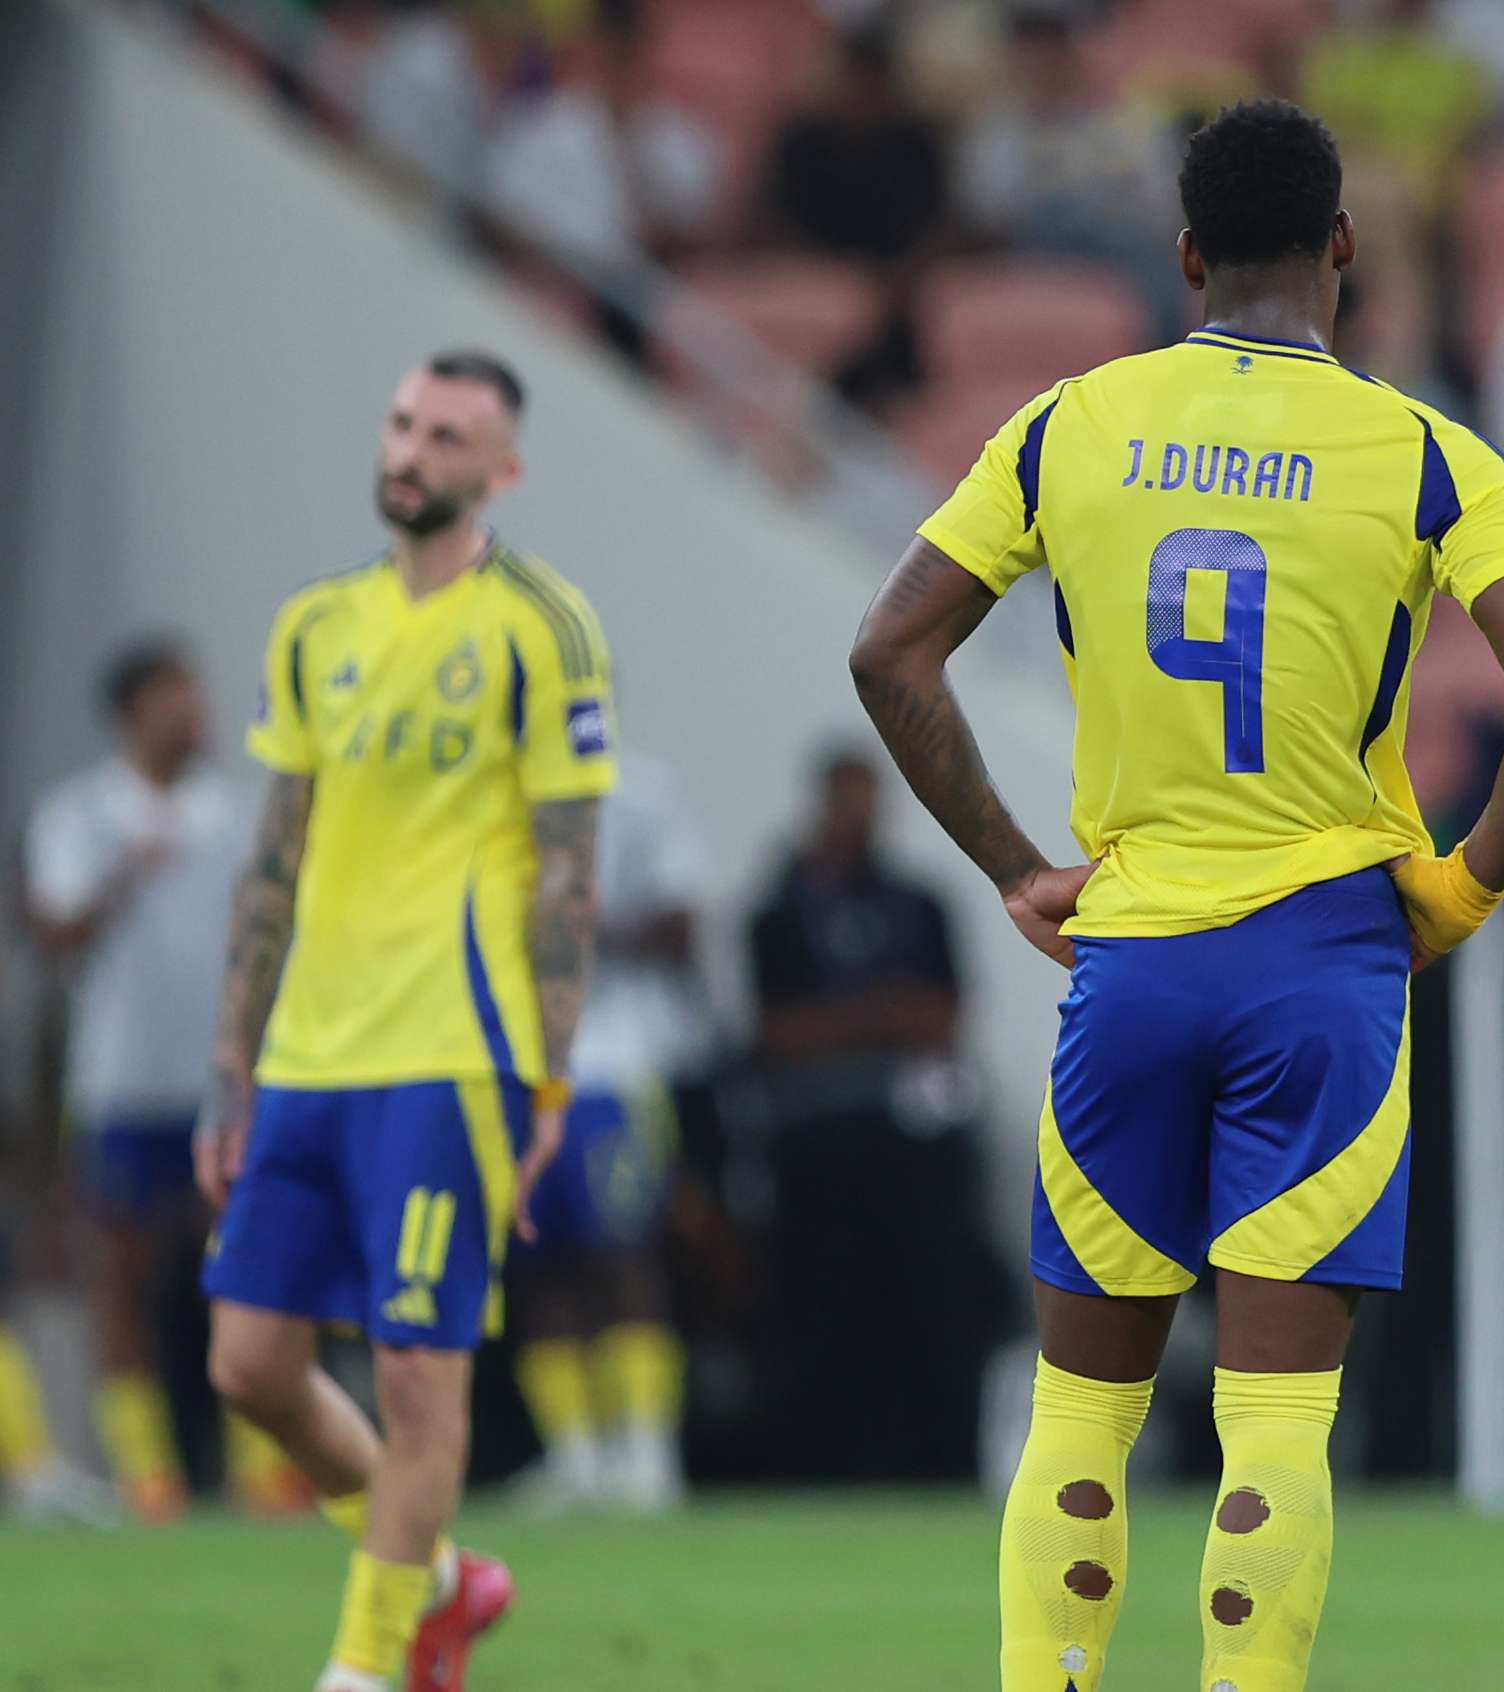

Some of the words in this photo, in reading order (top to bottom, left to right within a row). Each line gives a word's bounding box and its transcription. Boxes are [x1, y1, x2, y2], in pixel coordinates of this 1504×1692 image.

[1121, 438, 1313, 502] J.DURAN
[1145, 527, 1267, 775] 9
[396, 1184, 458, 1285] 11
